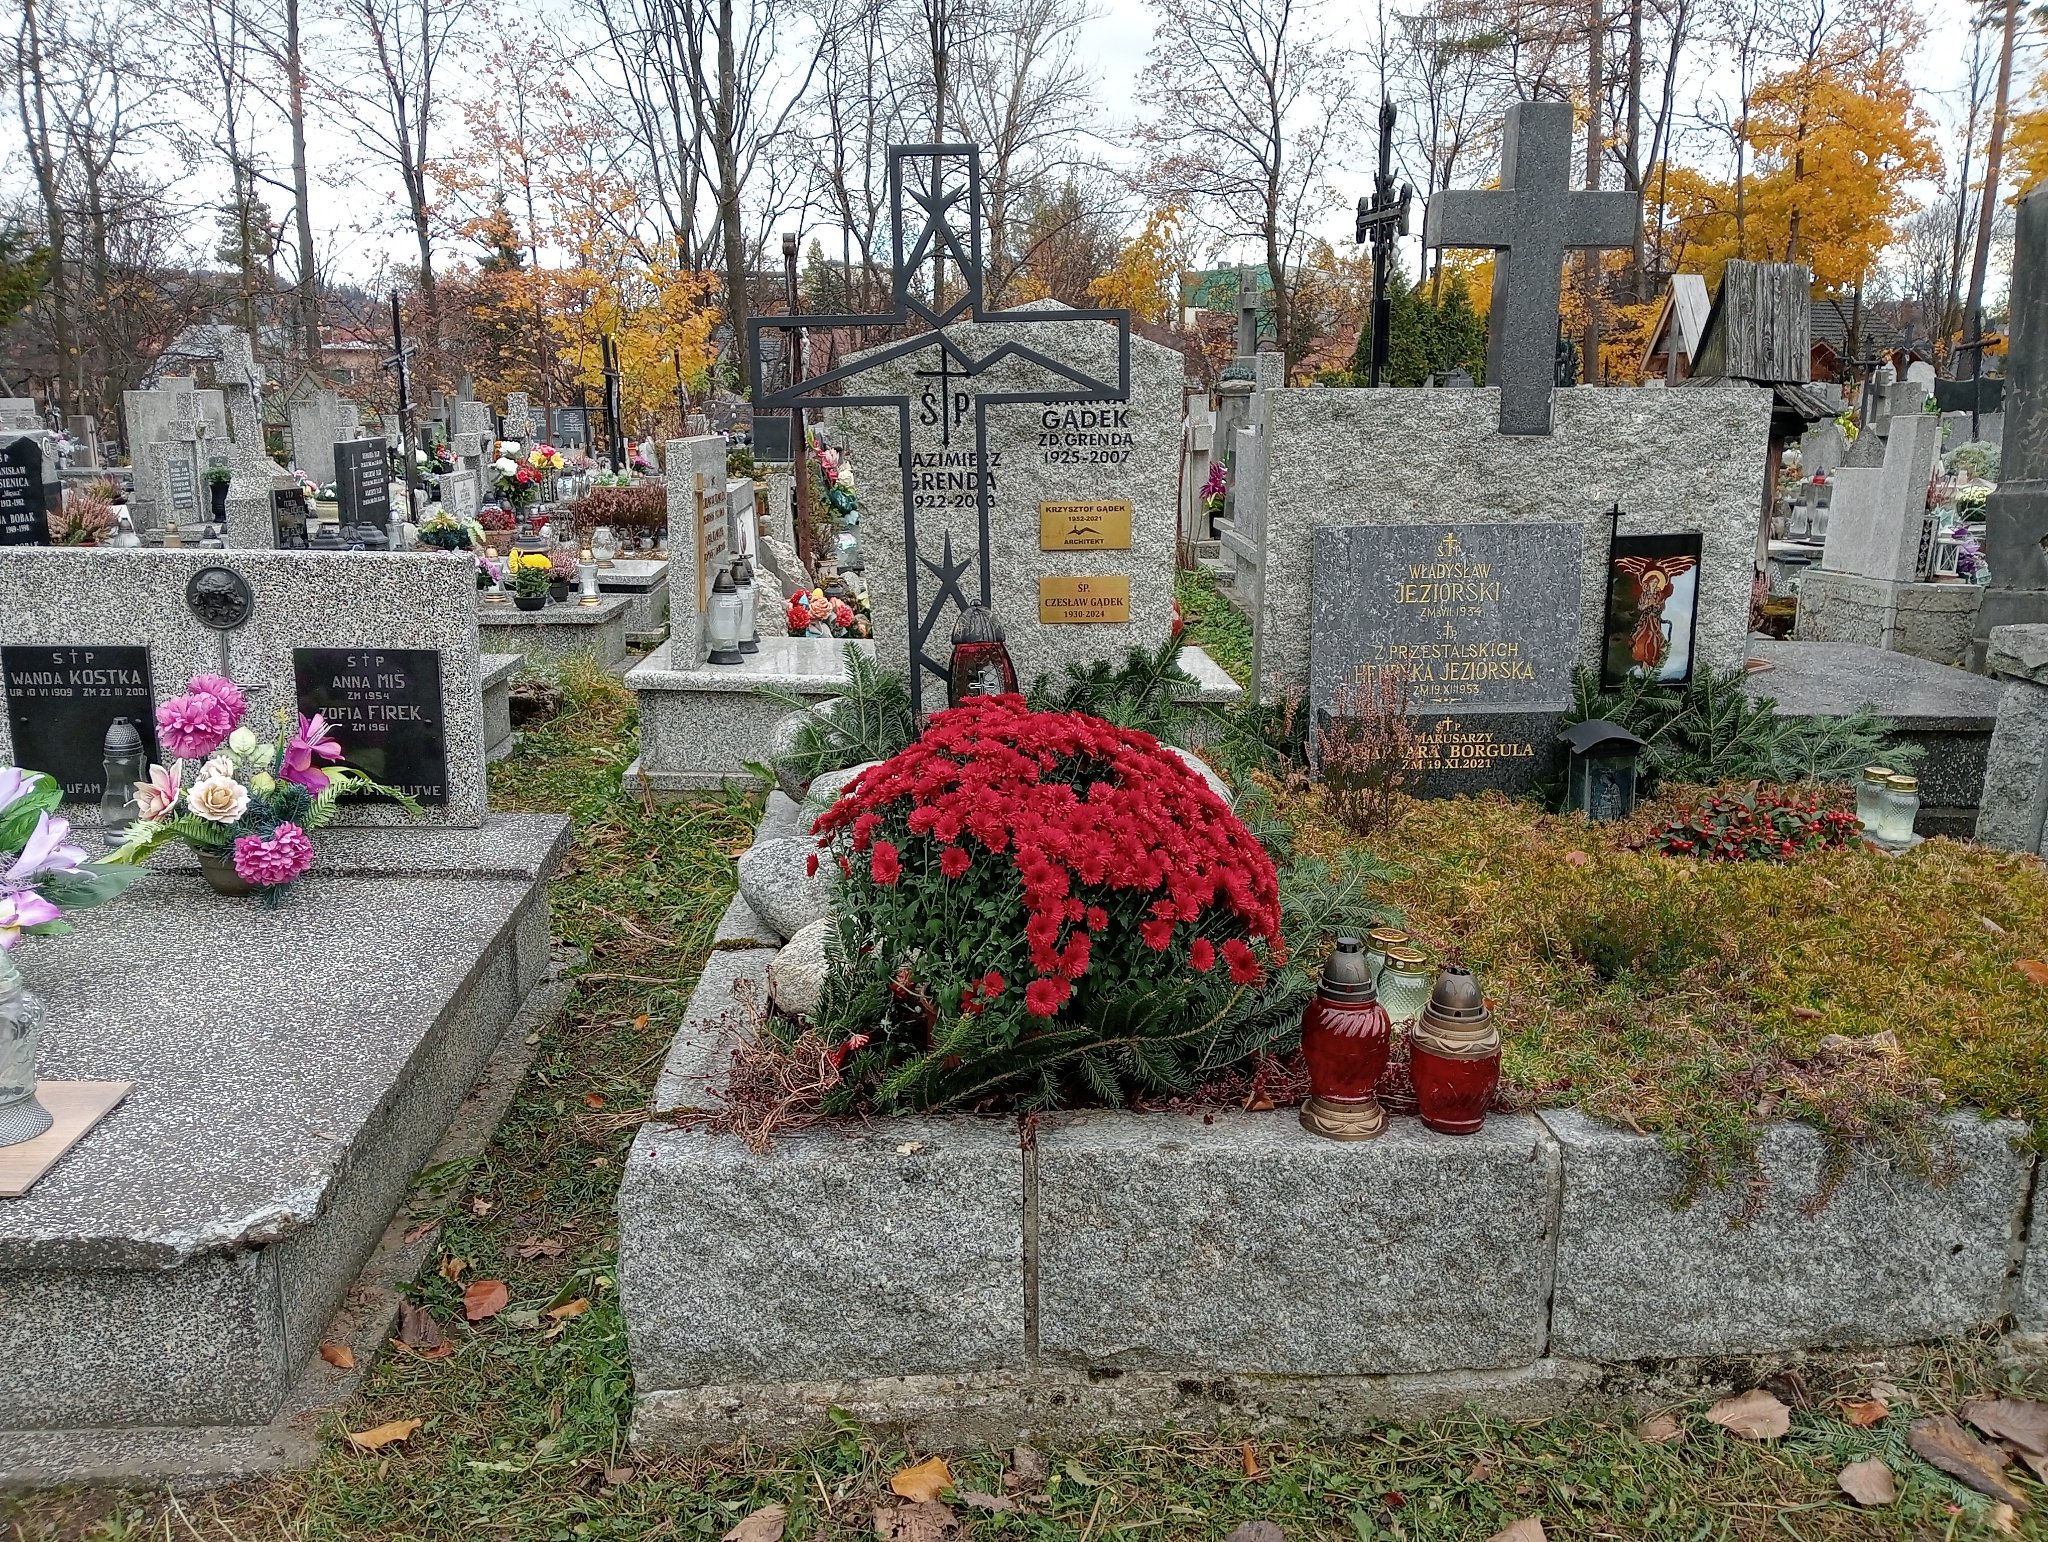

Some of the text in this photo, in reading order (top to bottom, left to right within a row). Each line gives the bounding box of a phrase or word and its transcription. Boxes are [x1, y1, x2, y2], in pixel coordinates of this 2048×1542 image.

[898, 452, 1001, 467] AZIMIEZ
[1045, 450, 1130, 463] 1925-2007
[914, 494, 996, 508] 922-203
[9, 511, 35, 524] BOBAK
[1408, 563, 1492, 579] WŁADYSŁAW
[1395, 582, 1500, 603] JEZIORSKI
[1045, 597, 1124, 608] CZESŁAW GĄDEK
[1064, 610, 1105, 618] 1930-2024
[10, 669, 142, 685] WANDA KOSTKA
[1439, 661, 1535, 681] JEZIORSKA
[332, 675, 371, 689] ANNA
[9, 688, 23, 697] UR
[82, 688, 97, 697] ZM
[126, 688, 148, 697] 2001
[365, 692, 390, 700] 1954
[319, 705, 422, 720] ZOFIA FIREK
[369, 723, 389, 732] 1961
[1449, 744, 1535, 758] BORGULA
[66, 783, 101, 794] UFAM
